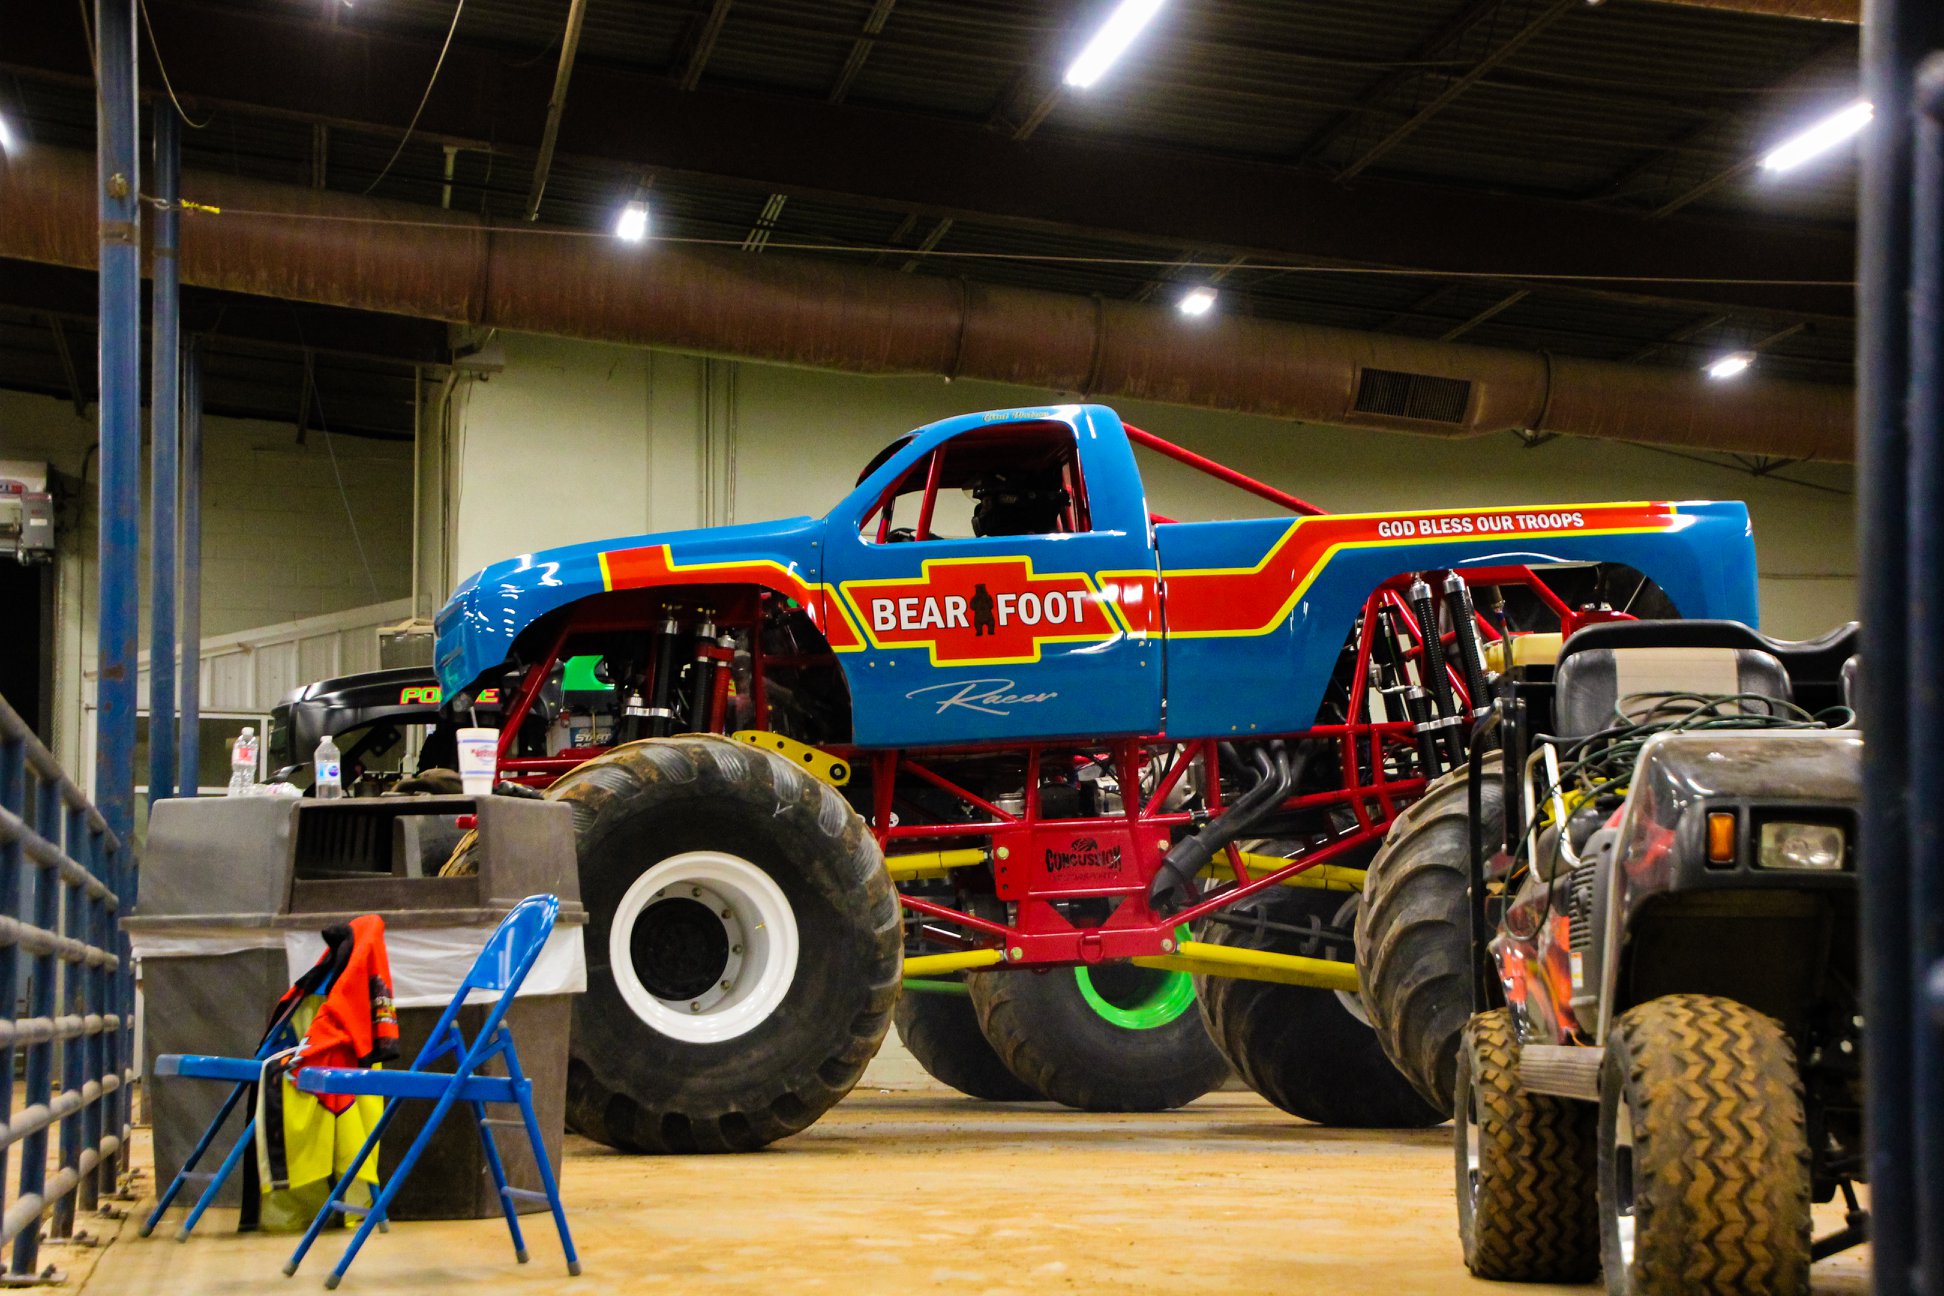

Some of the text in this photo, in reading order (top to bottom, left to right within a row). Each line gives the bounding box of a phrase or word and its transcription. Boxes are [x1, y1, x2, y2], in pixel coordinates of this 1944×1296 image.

[1378, 512, 1585, 538] GOD BLESS OUR TROOPS
[871, 590, 1087, 631] BEAR FOOT
[400, 686, 500, 705] POE
[905, 678, 1058, 716] Racer
